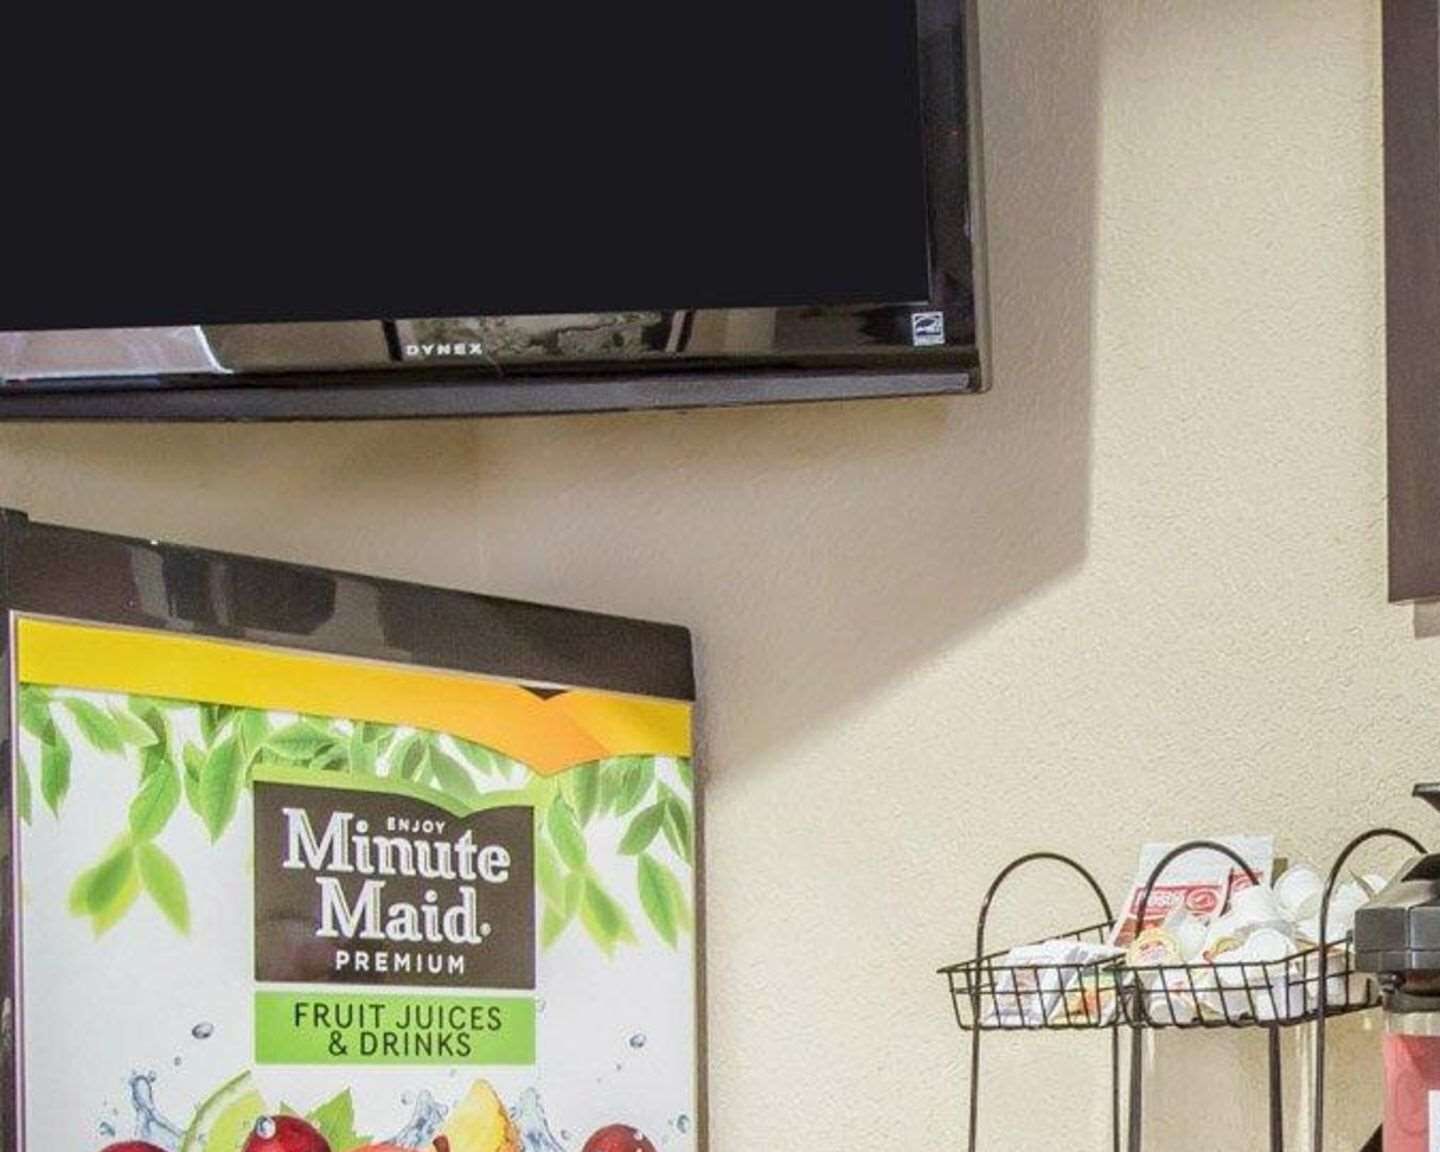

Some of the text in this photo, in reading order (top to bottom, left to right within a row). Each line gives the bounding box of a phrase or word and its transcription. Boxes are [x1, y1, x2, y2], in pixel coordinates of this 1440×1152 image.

[406, 343, 482, 356] DYNEX
[387, 817, 446, 834] ENJOY
[282, 807, 511, 883] Minute
[335, 951, 465, 974] PREMIUM
[294, 1002, 502, 1031] FRUIT JUICES
[328, 1031, 472, 1057] & DRINKS
